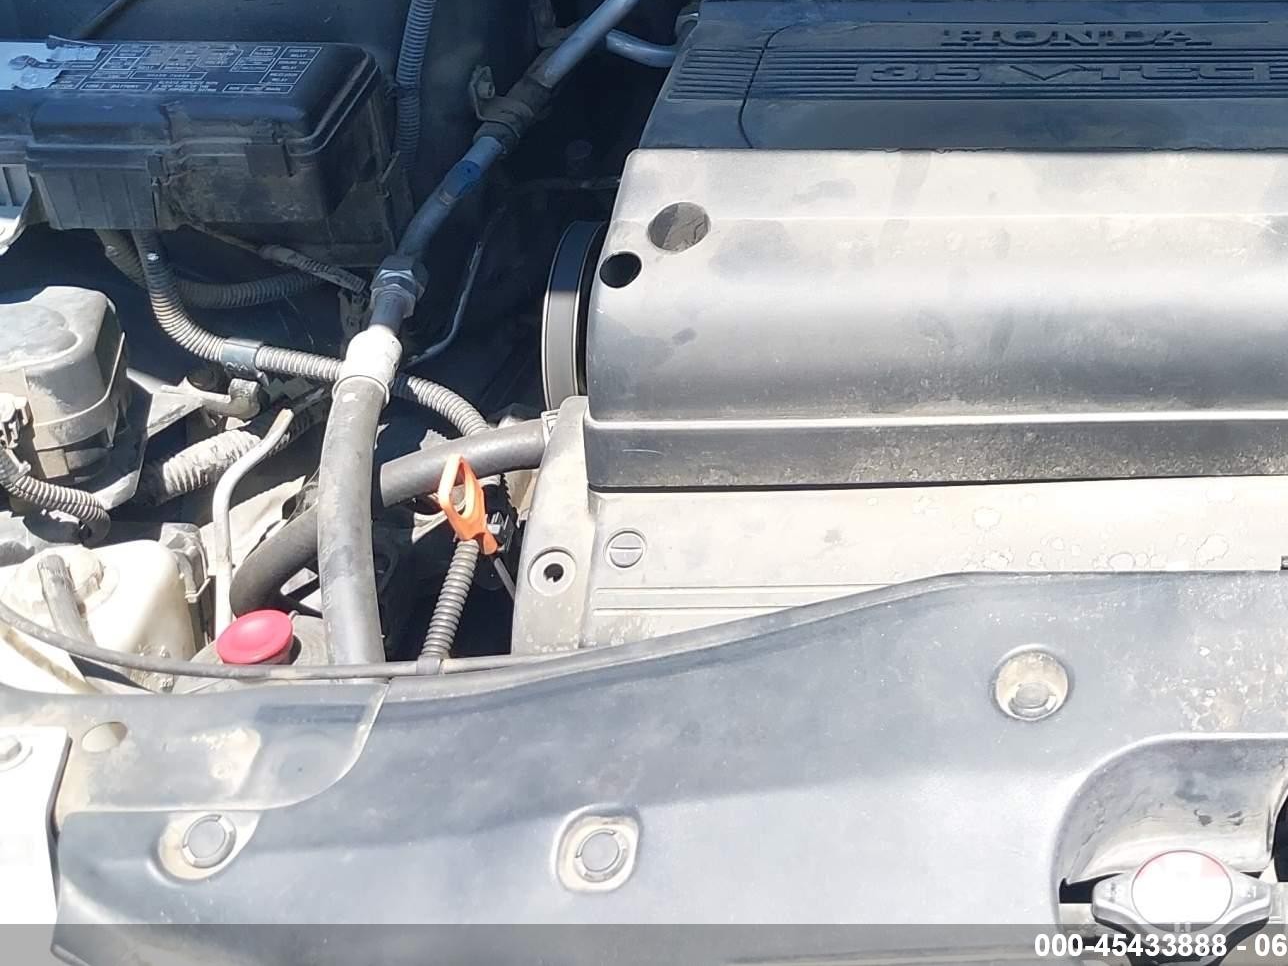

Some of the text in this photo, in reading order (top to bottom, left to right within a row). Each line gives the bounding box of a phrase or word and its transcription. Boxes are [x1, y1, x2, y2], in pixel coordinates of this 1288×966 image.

[940, 29, 1214, 48] HONDA
[870, 64, 1256, 82] 3.5 VTEC
